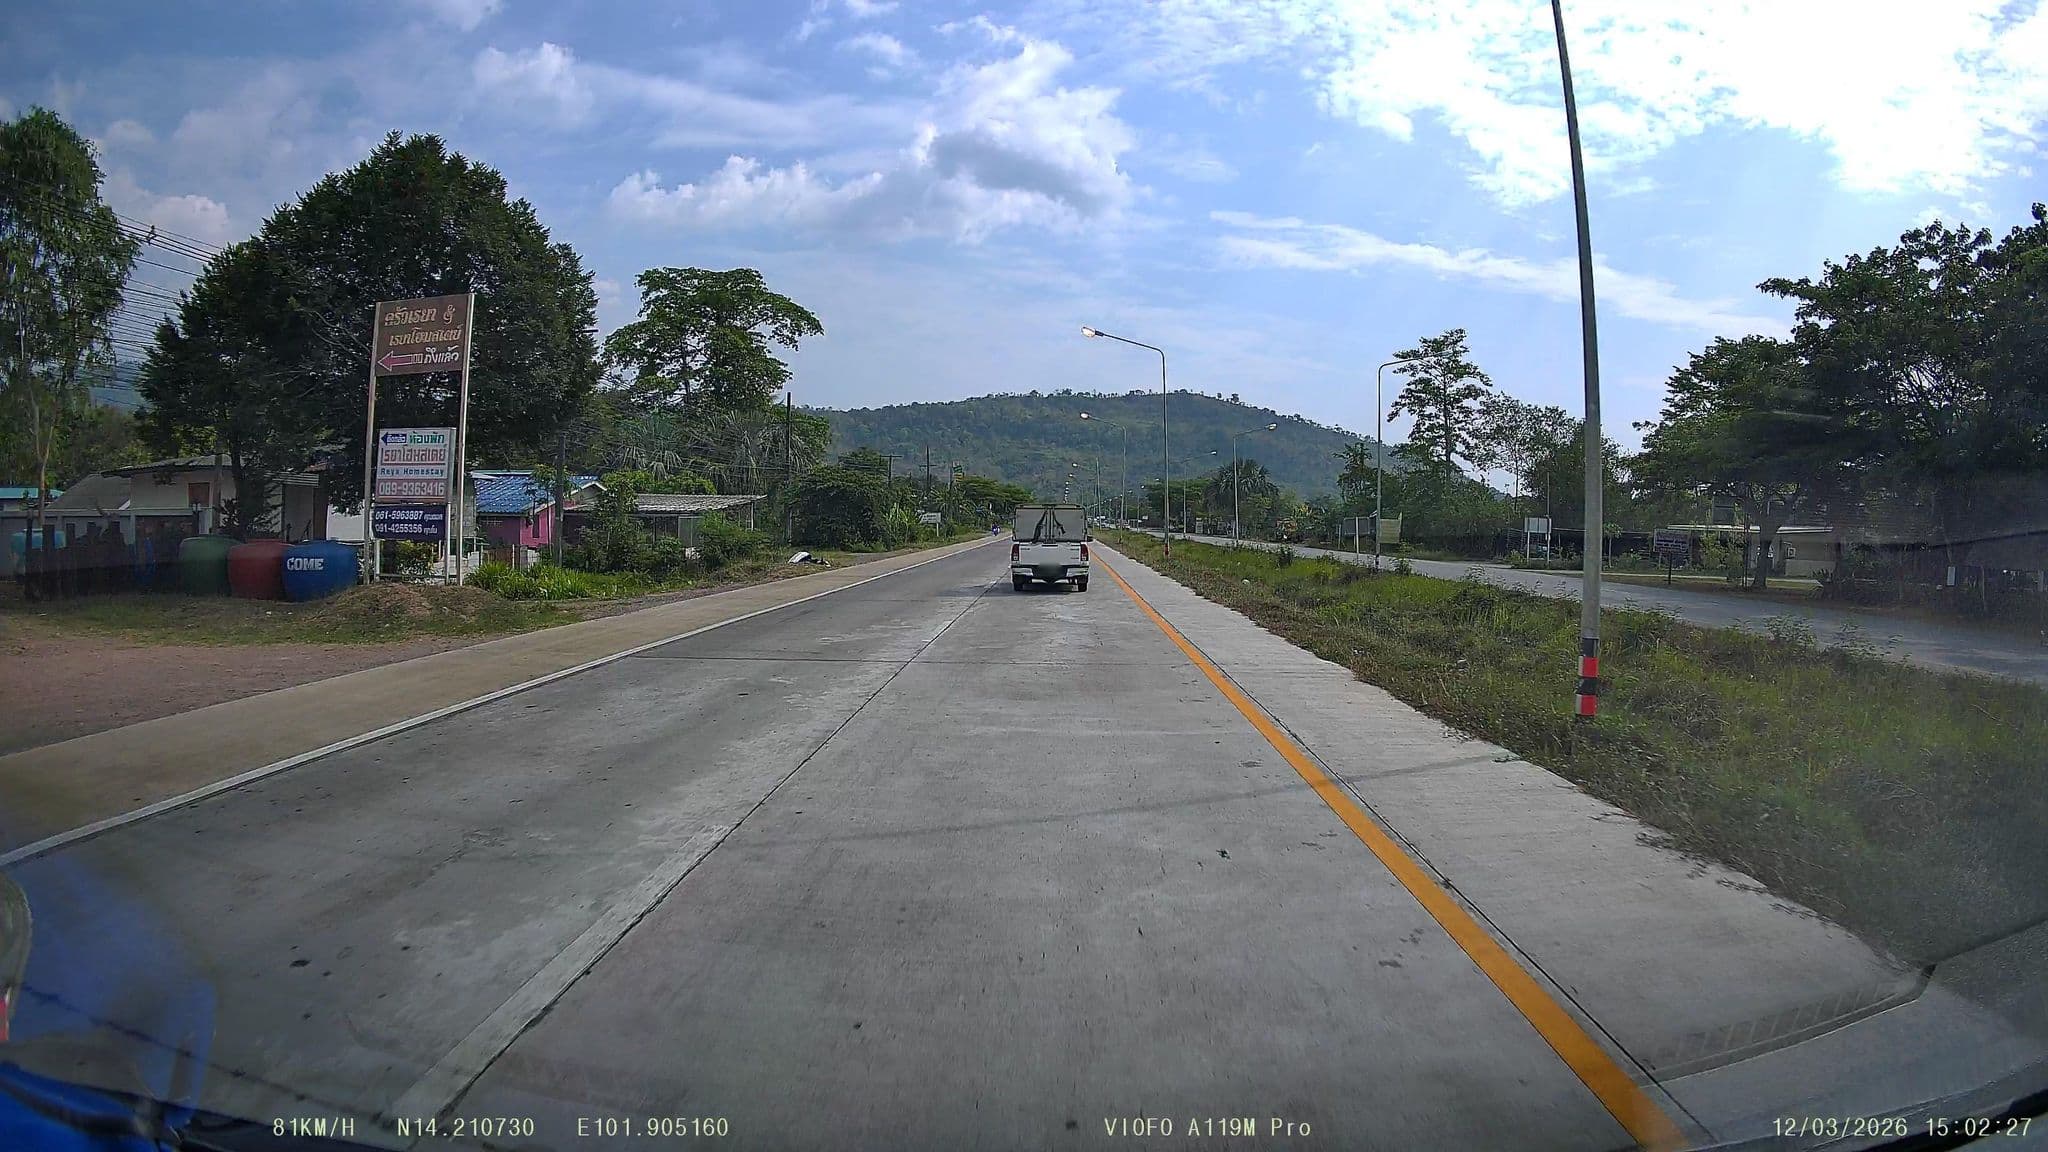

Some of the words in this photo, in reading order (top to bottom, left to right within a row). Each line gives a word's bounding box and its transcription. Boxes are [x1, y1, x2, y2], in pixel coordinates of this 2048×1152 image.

[424, 345, 460, 364] ถึงแล้ว
[409, 431, 445, 444] ห้องพัก
[381, 444, 448, 465] เรยาโฮมสเตย์
[403, 468, 444, 477] Homestay
[379, 481, 445, 496] 089-9363416
[286, 557, 325, 571] COME
